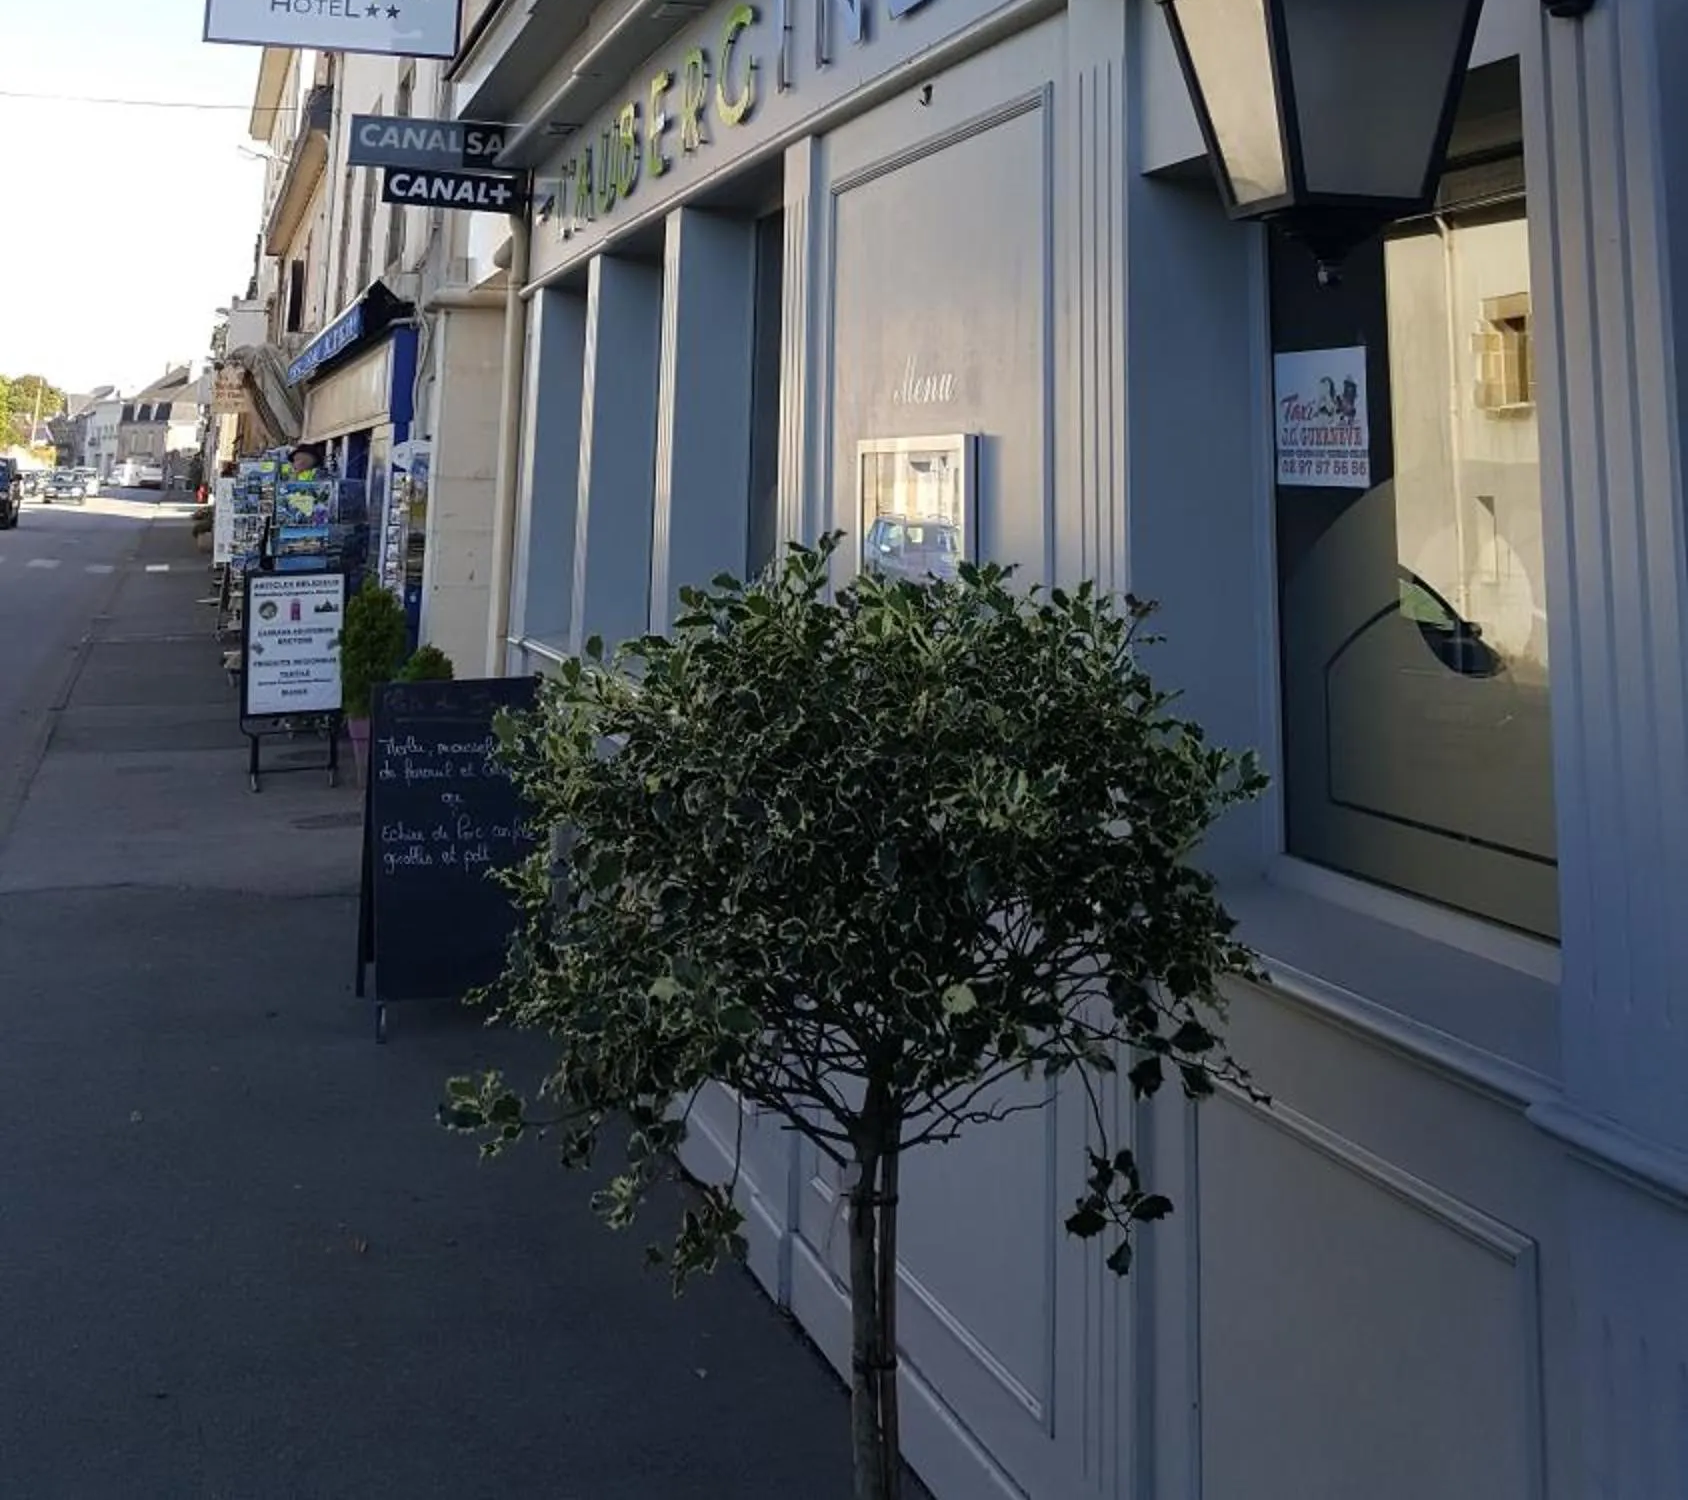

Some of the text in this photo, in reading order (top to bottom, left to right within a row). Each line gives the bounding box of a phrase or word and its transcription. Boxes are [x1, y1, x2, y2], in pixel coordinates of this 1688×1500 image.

[388, 173, 513, 205] CANAL+
[893, 354, 959, 405] Menu
[1280, 392, 1316, 424] Taxi
[1298, 460, 1313, 476] 97
